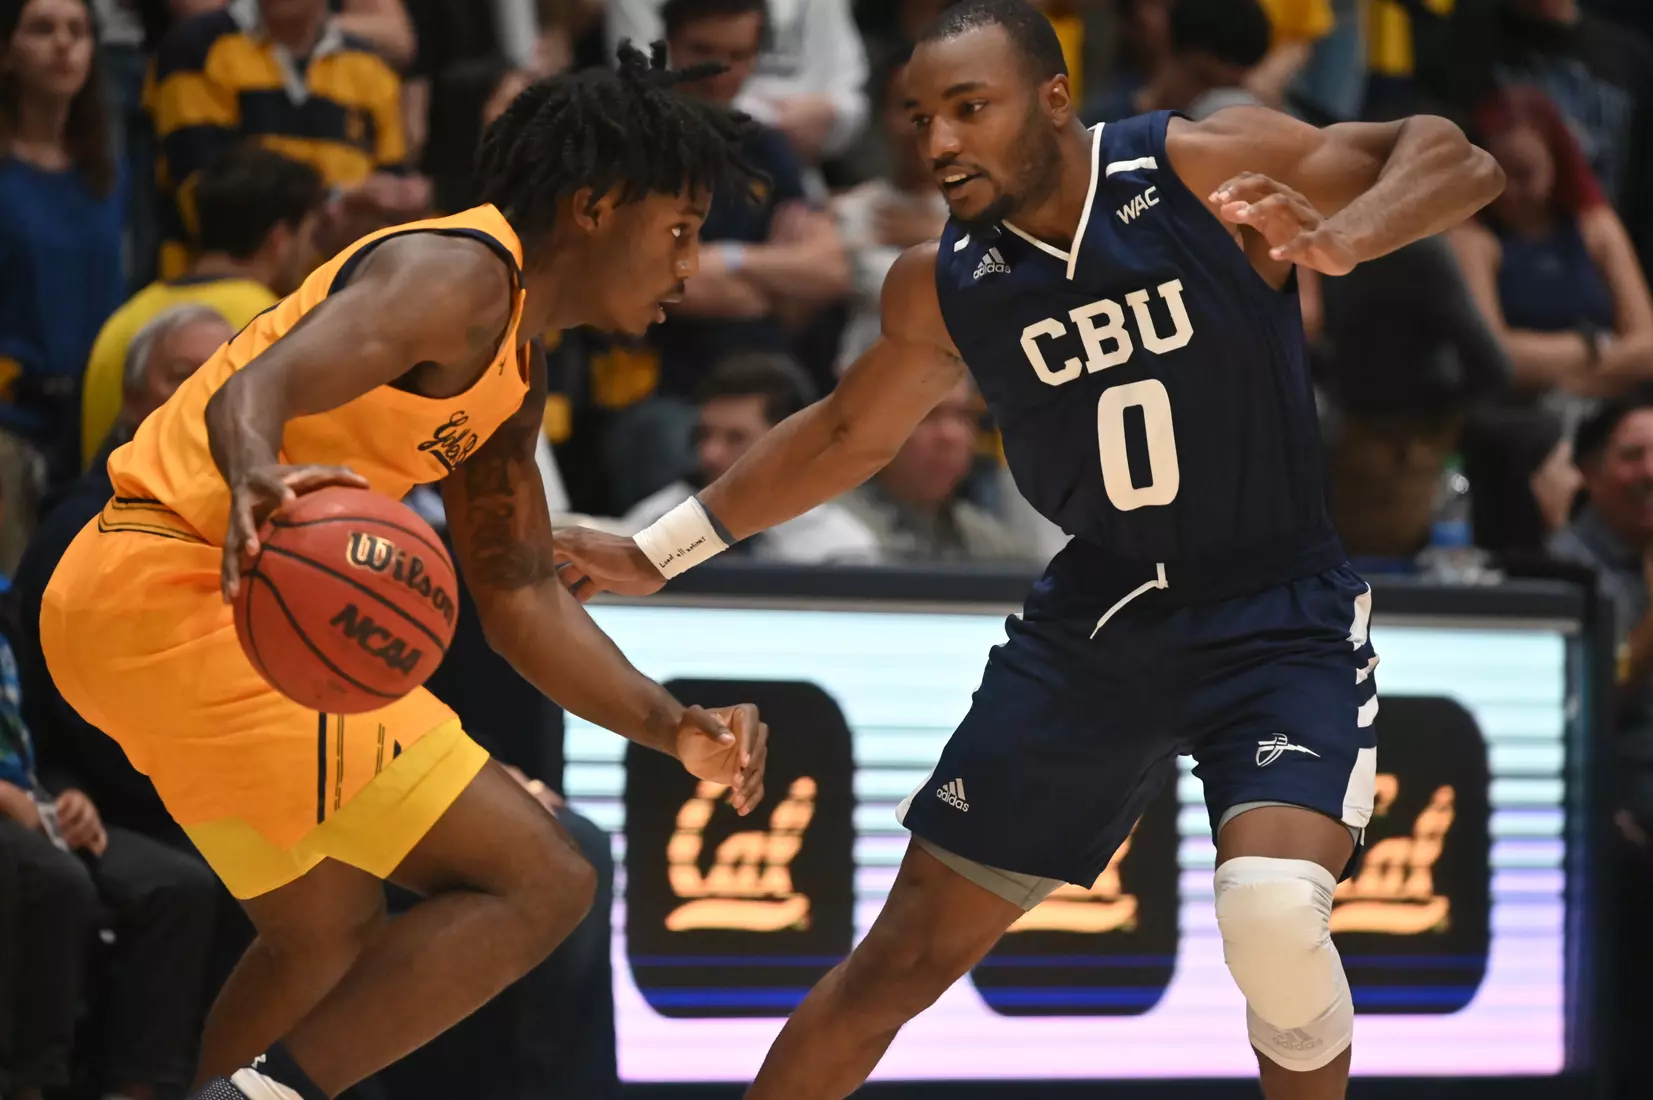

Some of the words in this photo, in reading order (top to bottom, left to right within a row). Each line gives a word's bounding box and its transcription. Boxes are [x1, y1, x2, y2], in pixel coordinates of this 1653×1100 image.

[1116, 186, 1160, 225] WAC
[973, 262, 1011, 279] adidas
[1020, 279, 1194, 386] CBU
[1097, 379, 1180, 511] 0
[346, 531, 455, 627] Wilson
[330, 604, 422, 676] NCAA
[936, 788, 969, 812] adidas
